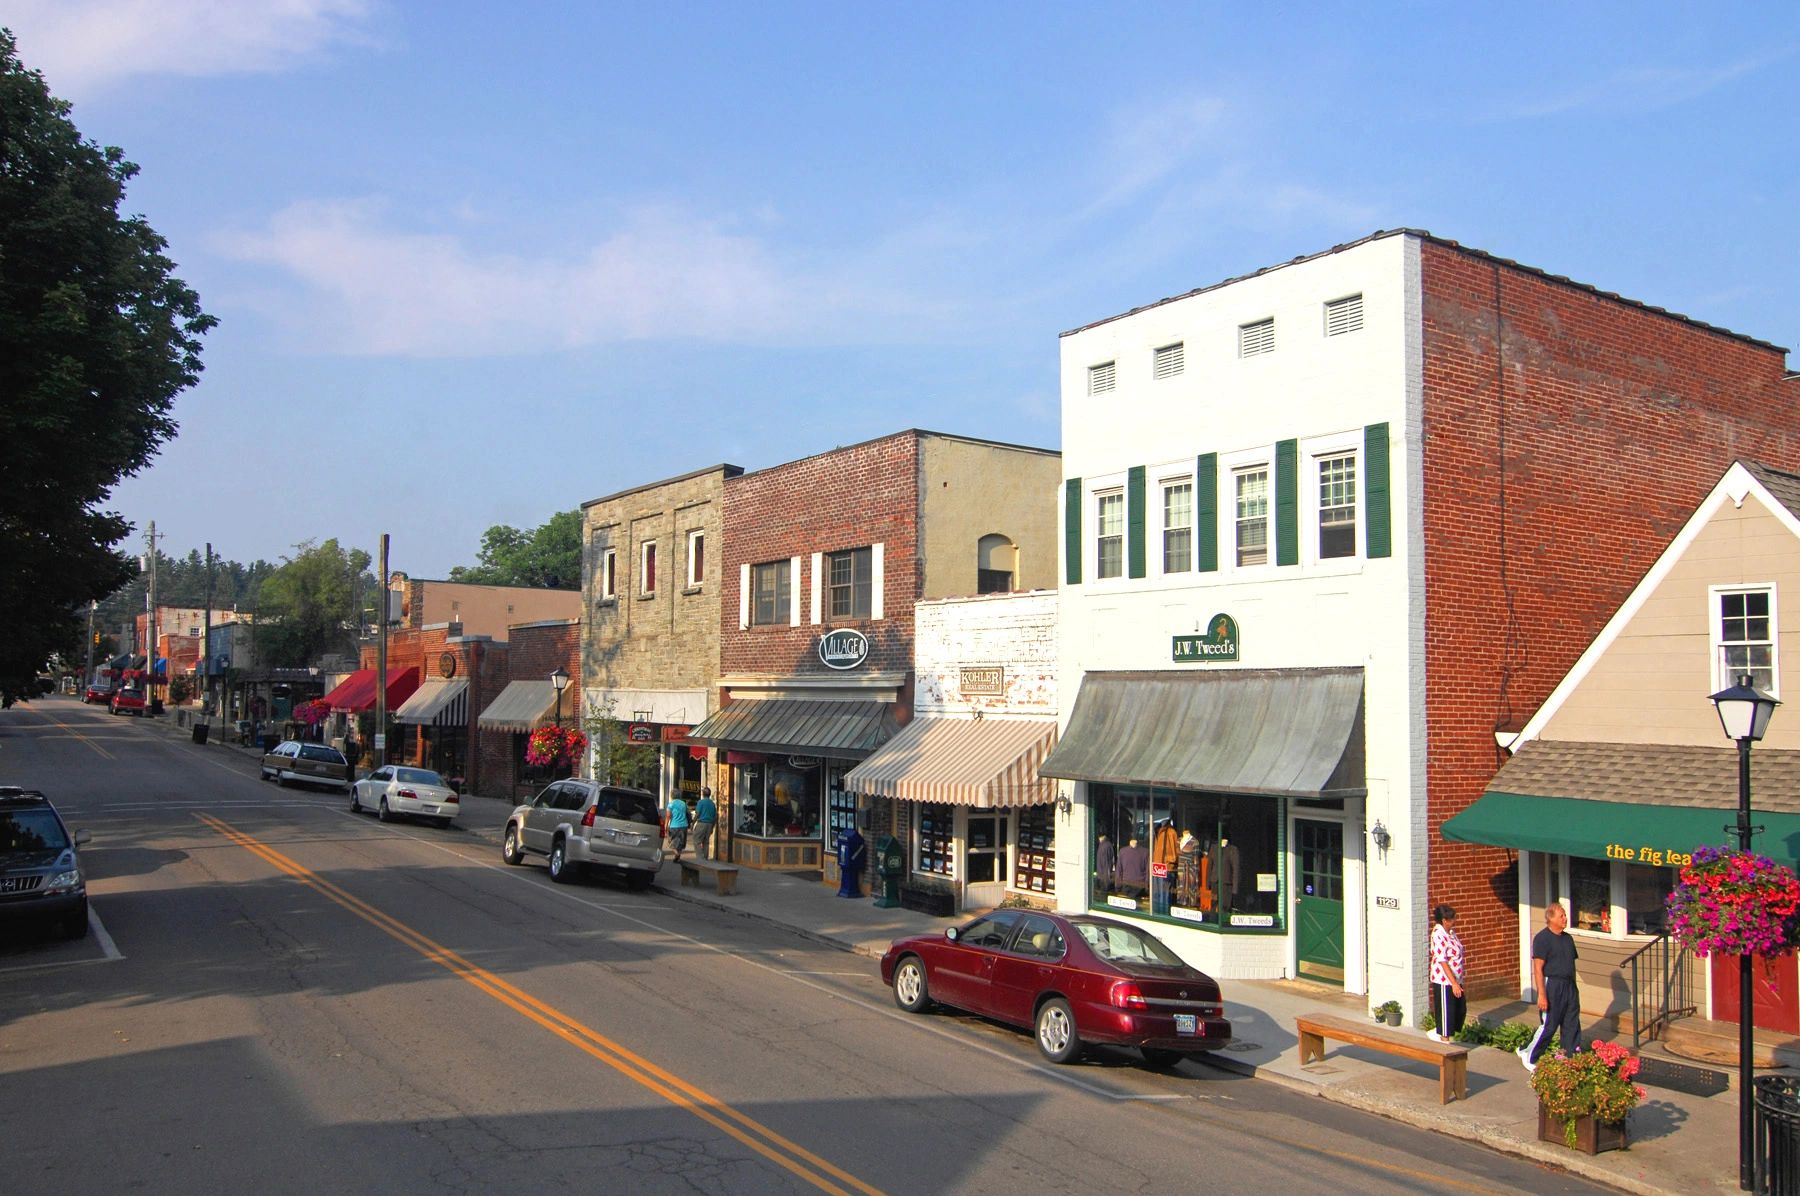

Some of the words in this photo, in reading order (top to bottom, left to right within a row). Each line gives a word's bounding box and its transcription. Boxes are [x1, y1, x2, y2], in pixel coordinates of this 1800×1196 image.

[821, 635, 859, 660] VILLAGE
[1175, 641, 1192, 655] J.W.
[1196, 640, 1235, 654] Tweed's
[960, 671, 999, 685] KOHLER
[1606, 844, 1635, 859] the
[1639, 847, 1663, 866] fig
[1666, 848, 1692, 866] lea
[1154, 865, 1167, 876] Sale
[1378, 897, 1397, 907] 1129
[1248, 917, 1273, 925] Tweeds
